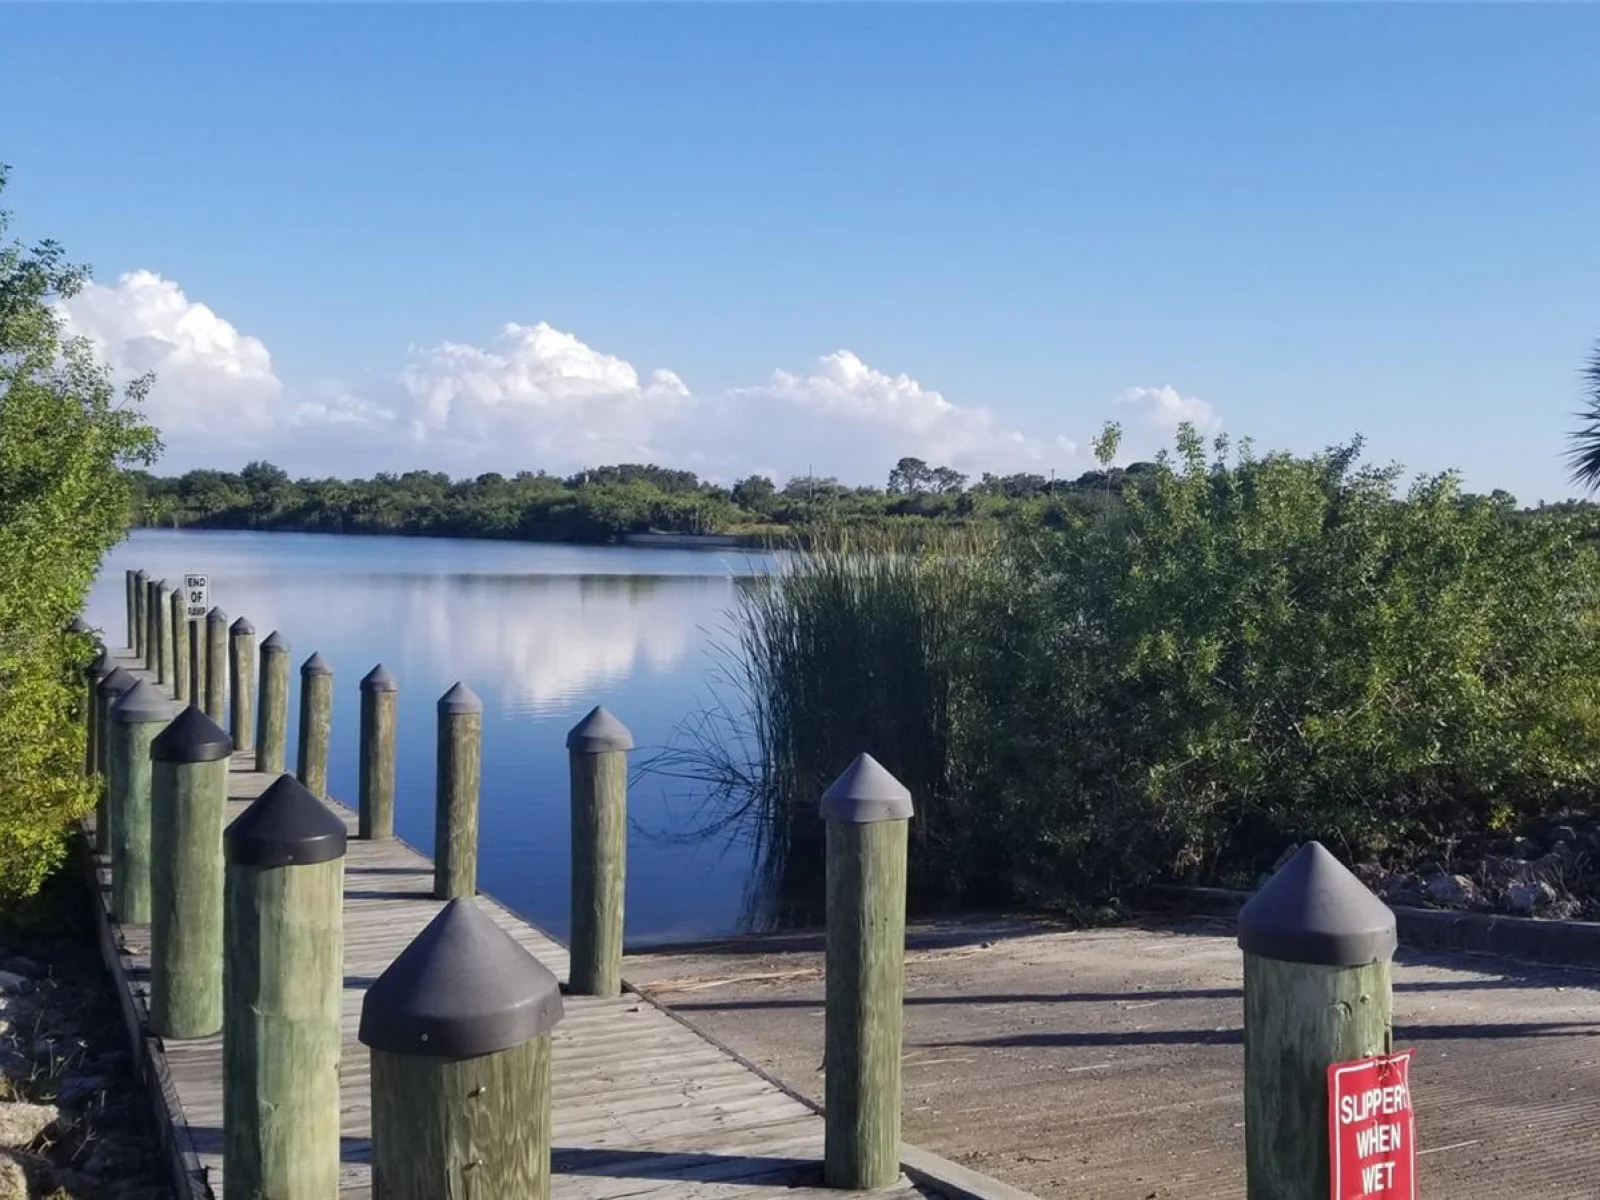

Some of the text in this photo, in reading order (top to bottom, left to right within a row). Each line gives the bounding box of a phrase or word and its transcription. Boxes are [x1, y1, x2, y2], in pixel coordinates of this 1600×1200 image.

[188, 577, 205, 587] END
[191, 591, 203, 602] OF
[1356, 1121, 1401, 1159] WHEN
[1361, 1161, 1396, 1196] WET
